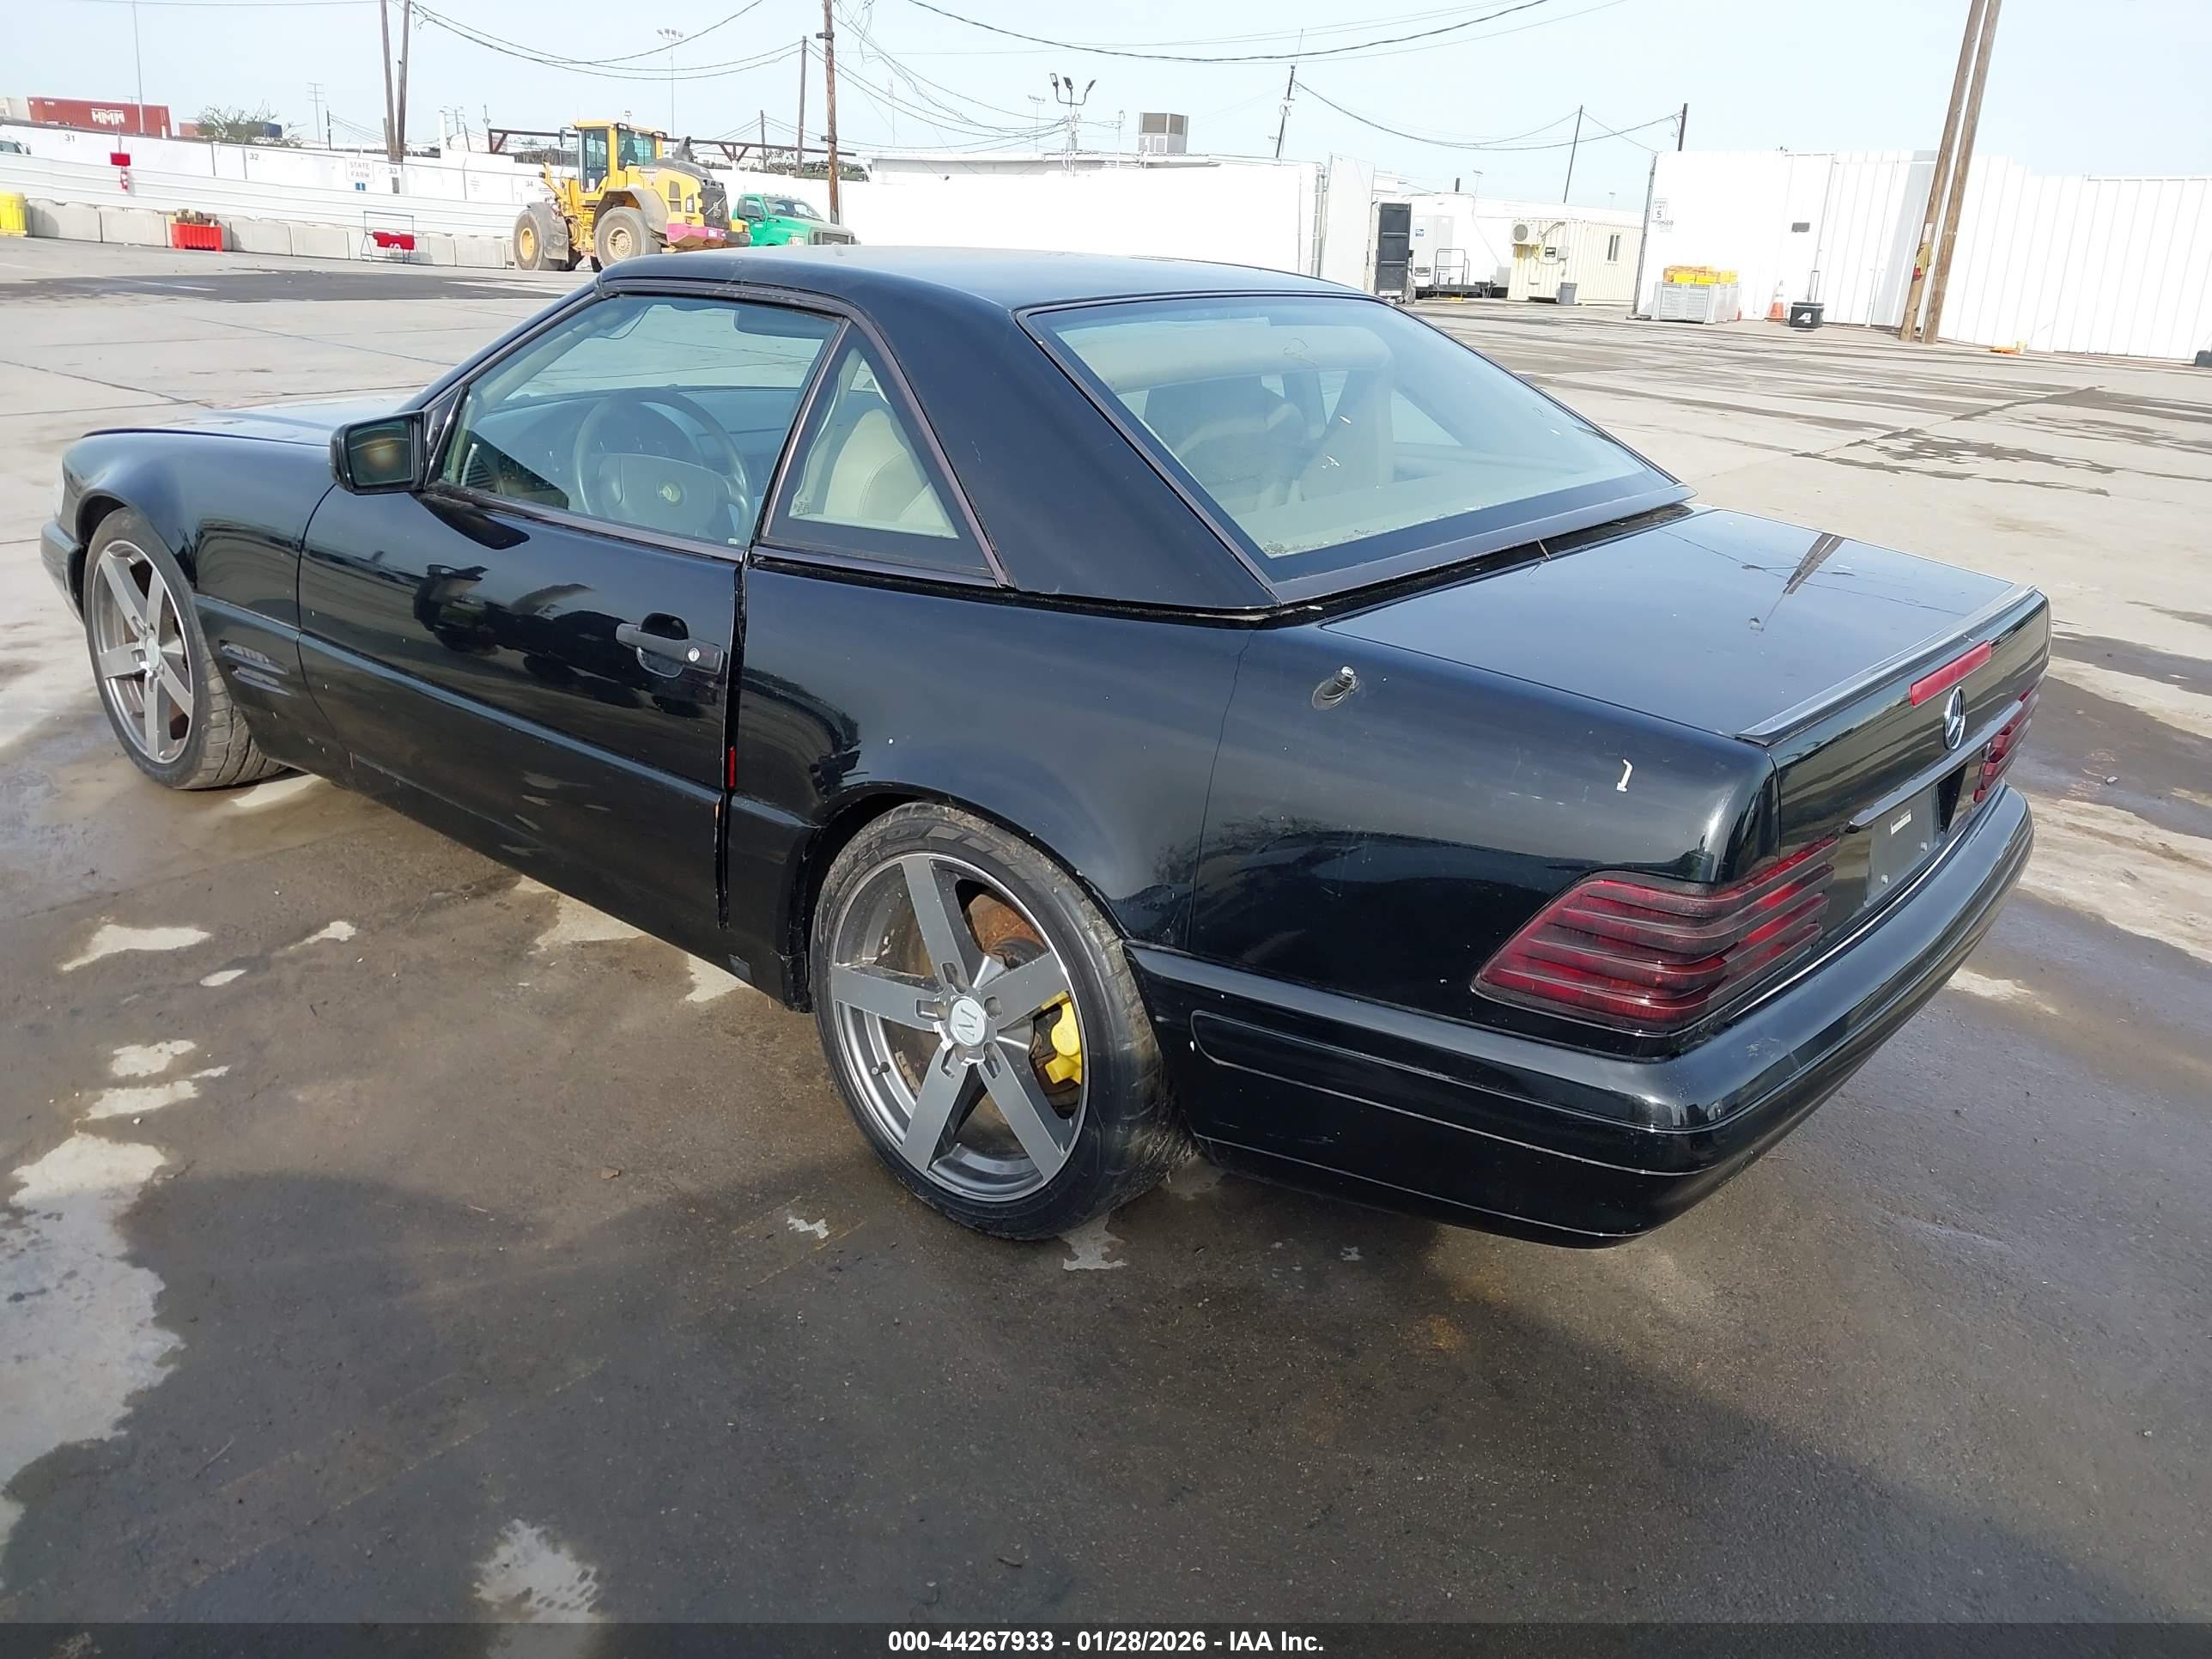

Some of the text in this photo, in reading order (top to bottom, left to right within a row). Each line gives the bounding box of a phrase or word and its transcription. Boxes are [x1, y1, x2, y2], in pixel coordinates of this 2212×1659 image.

[91, 107, 125, 125] HMM
[64, 134, 76, 143] 31
[349, 161, 370, 170] STATE
